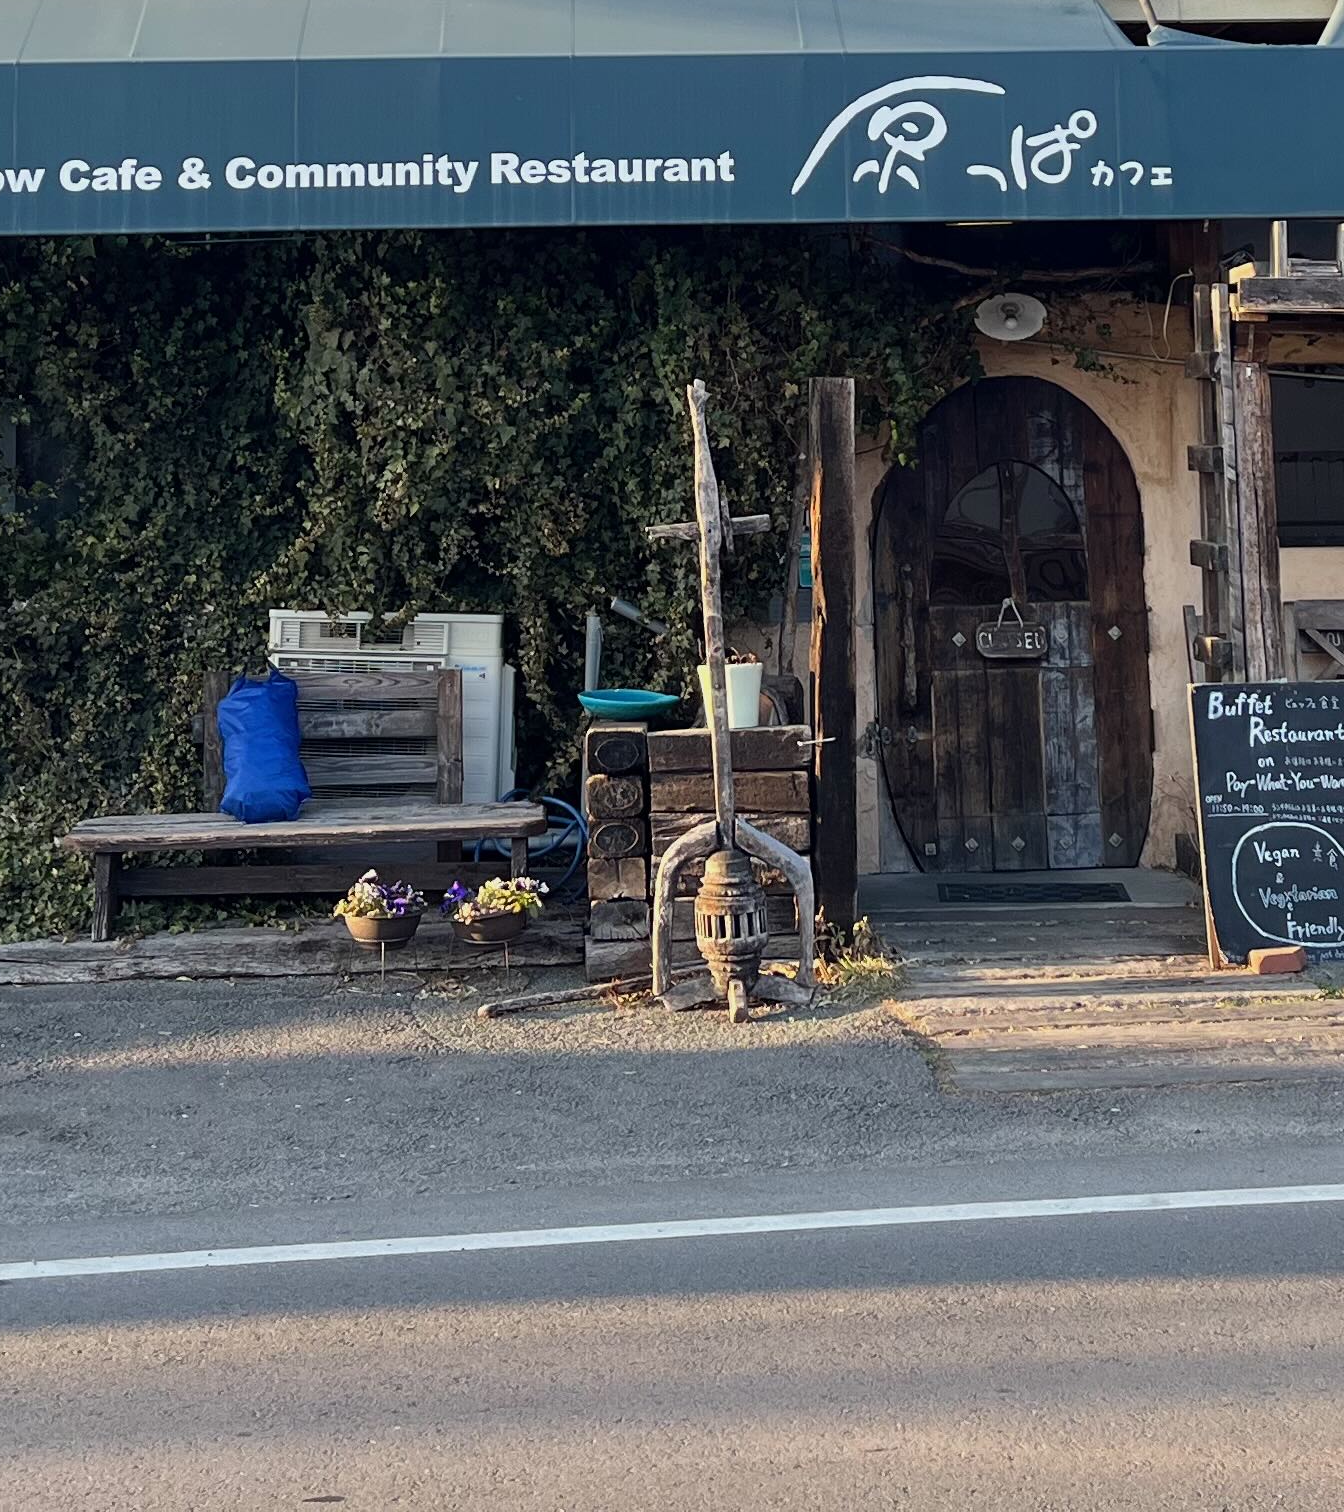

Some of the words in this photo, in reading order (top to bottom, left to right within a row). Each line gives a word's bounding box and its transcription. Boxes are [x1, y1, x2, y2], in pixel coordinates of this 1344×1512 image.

[58, 159, 163, 193] Cafe
[176, 157, 212, 190] &
[224, 154, 480, 193] Community
[489, 150, 736, 185] Restaurant
[1207, 690, 1274, 720] Buffet
[1257, 756, 1275, 768] on
[1253, 841, 1300, 867] Vegan
